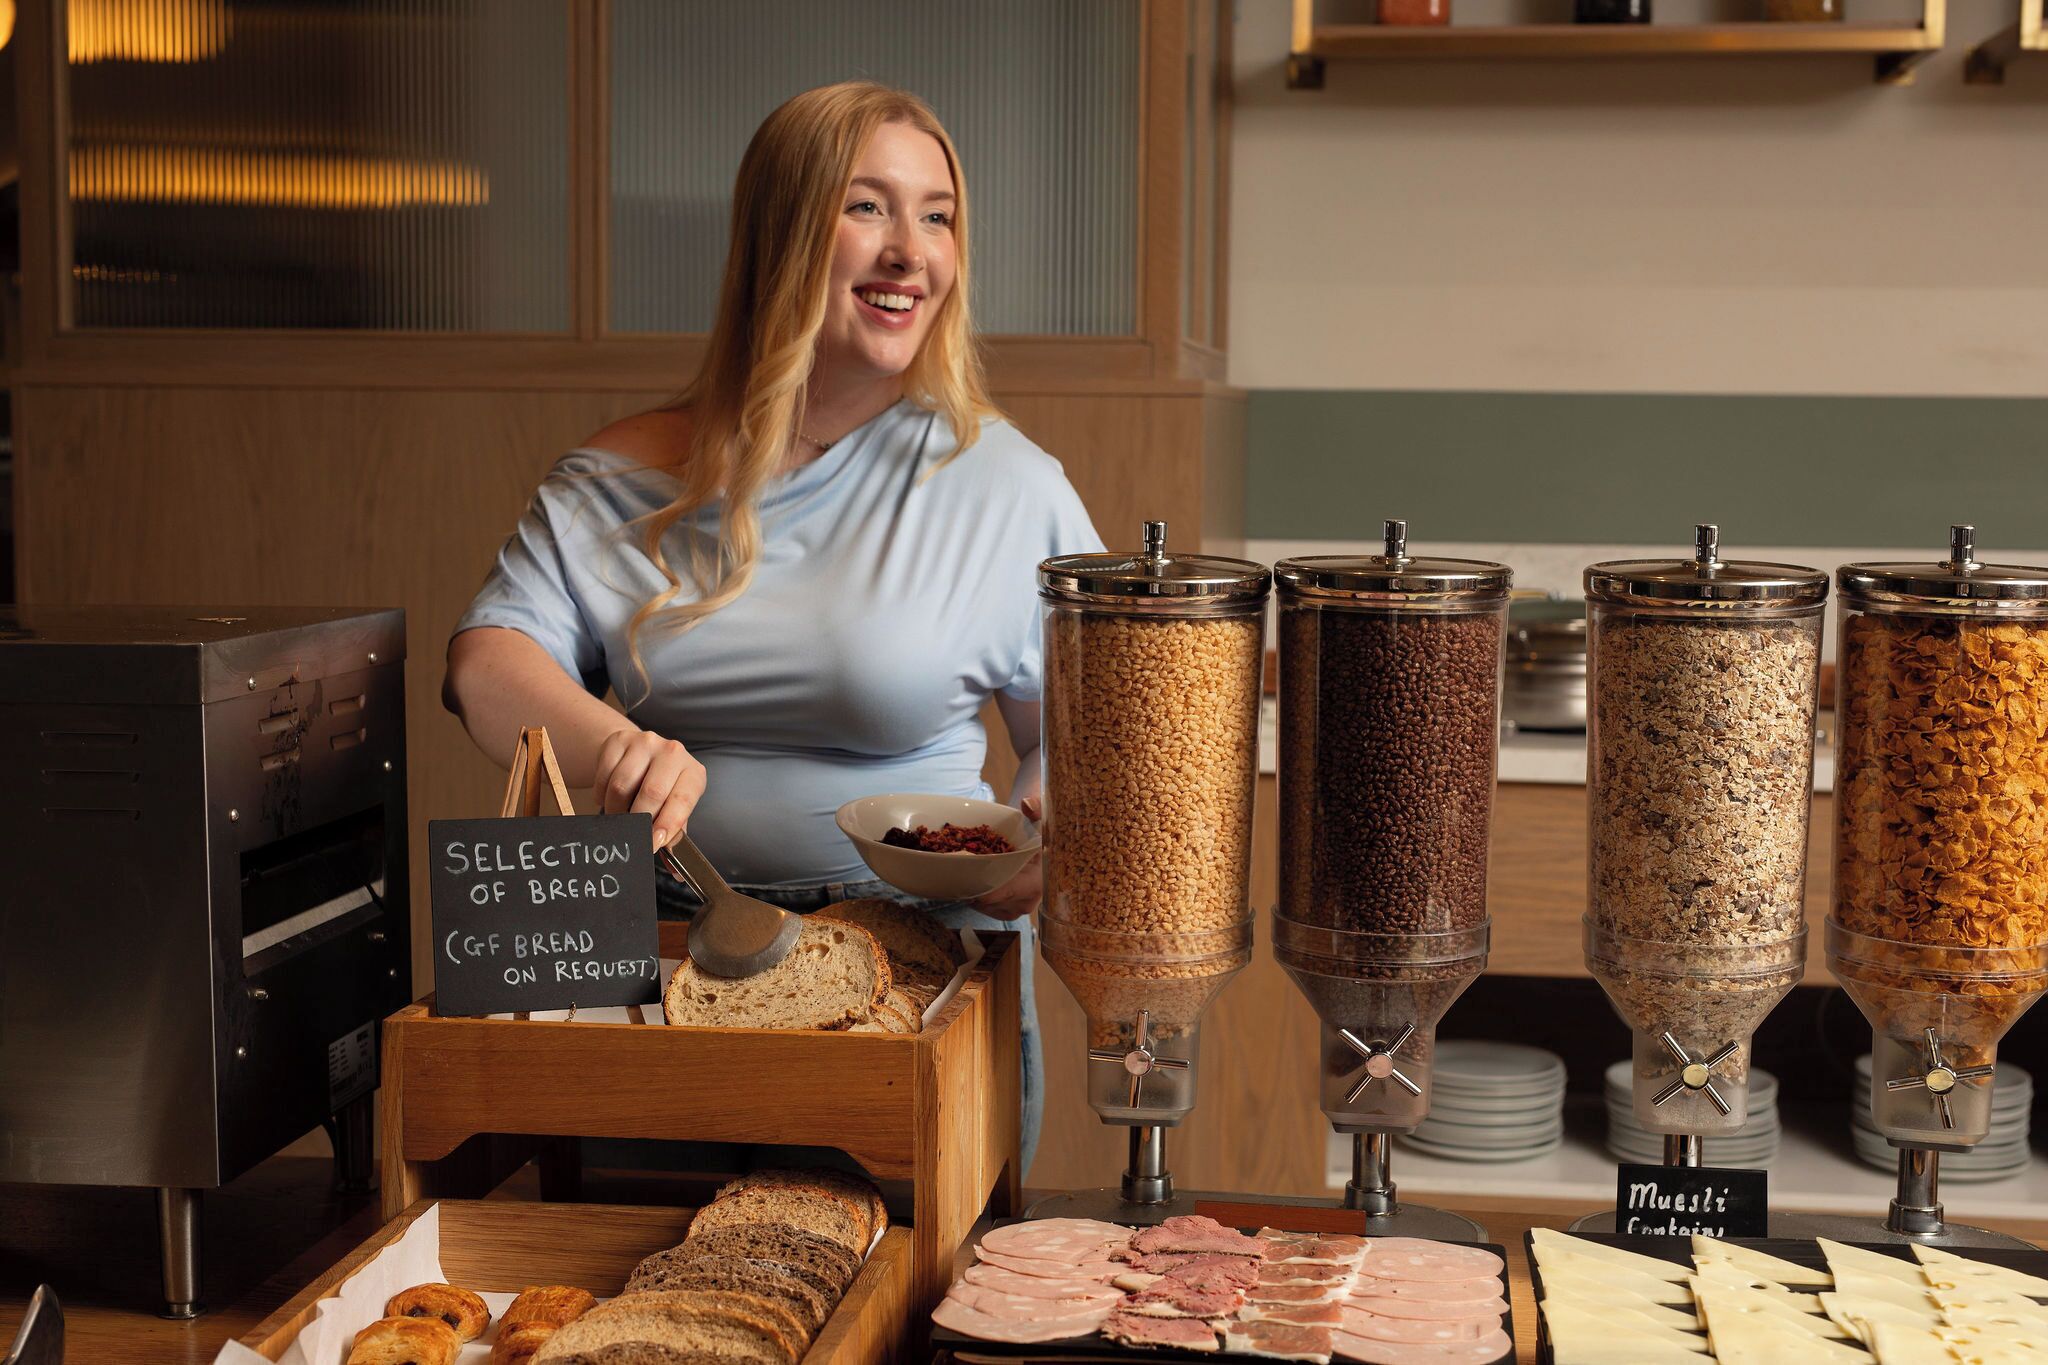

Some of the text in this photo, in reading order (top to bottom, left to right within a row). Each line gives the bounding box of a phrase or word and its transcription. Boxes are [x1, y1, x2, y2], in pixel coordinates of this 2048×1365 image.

[444, 841, 631, 874] SELECTION
[470, 874, 621, 905] OF BREAD
[445, 930, 594, 964] (GF BREAD
[503, 956, 659, 985] ON REQUEST)
[1628, 1182, 1729, 1213] Muesli
